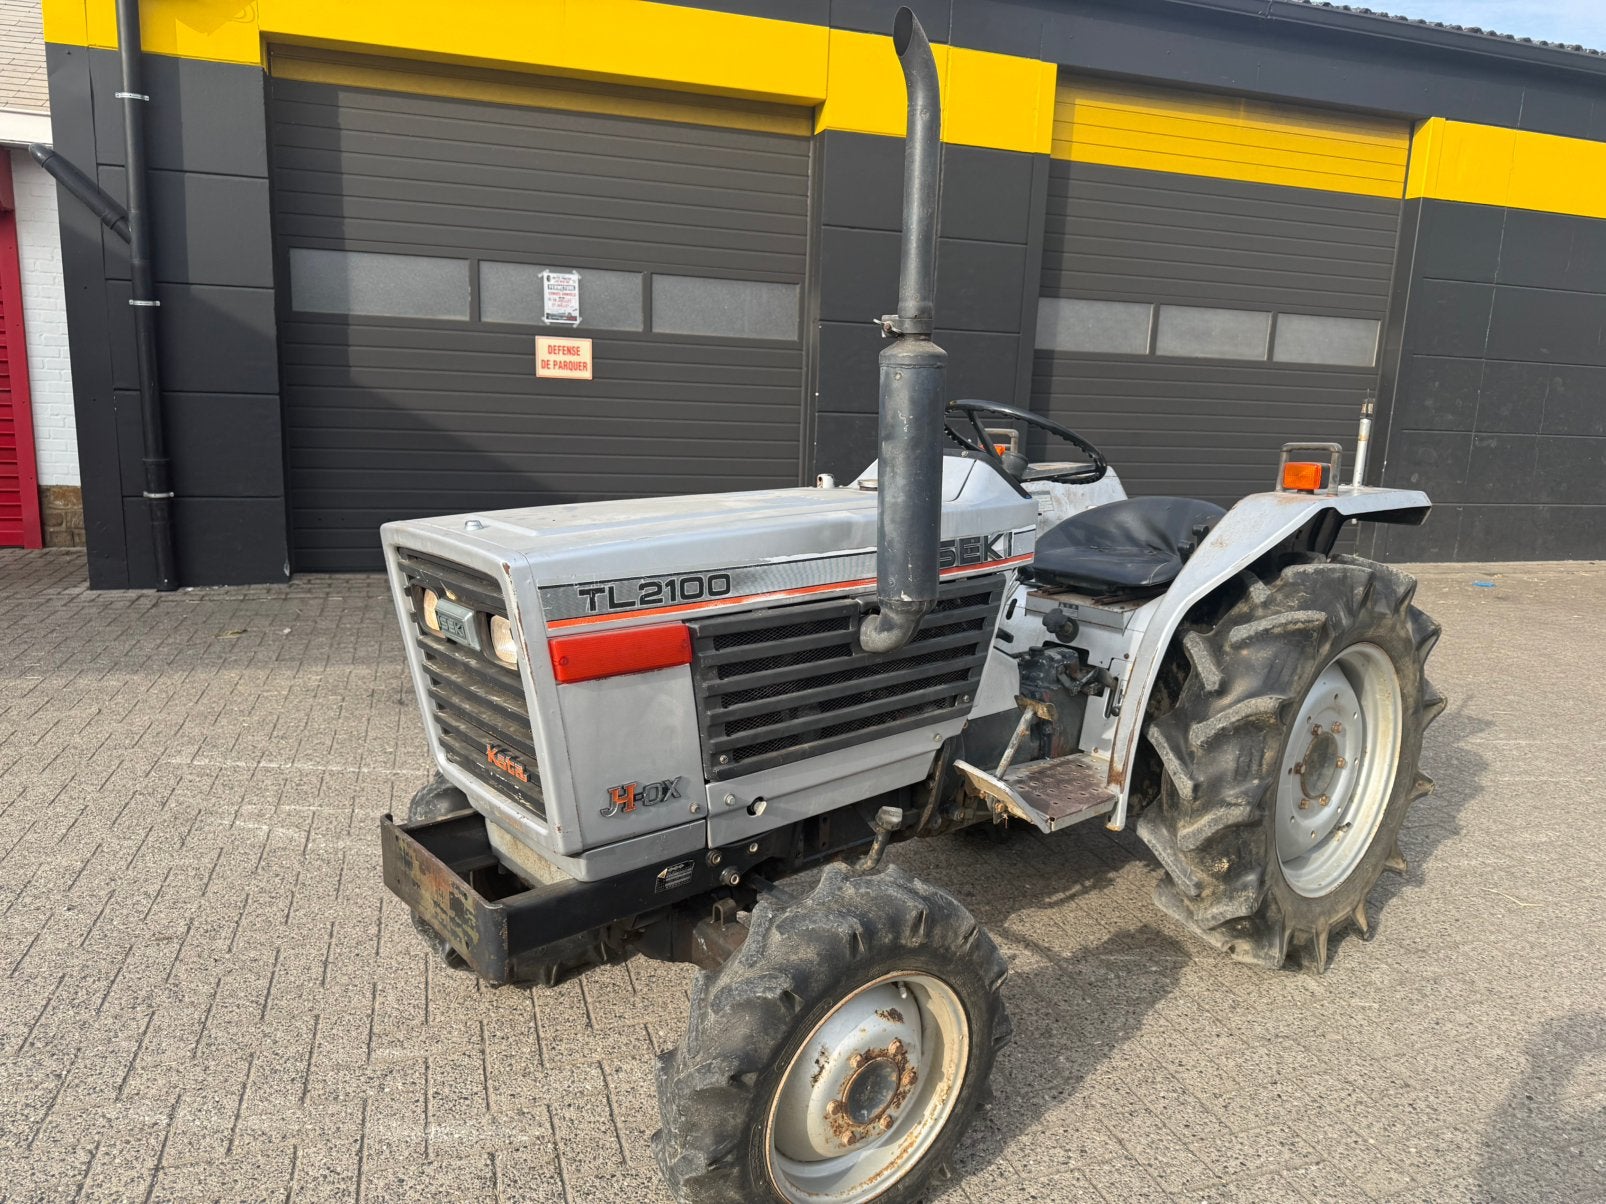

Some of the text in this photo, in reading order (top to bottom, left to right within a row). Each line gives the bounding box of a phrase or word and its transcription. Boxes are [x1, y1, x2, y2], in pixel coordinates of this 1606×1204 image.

[547, 344, 581, 357] DEFENSE
[541, 359, 588, 373] DE PARQUER
[939, 531, 1013, 569] SEKI
[578, 573, 731, 613] TL2100
